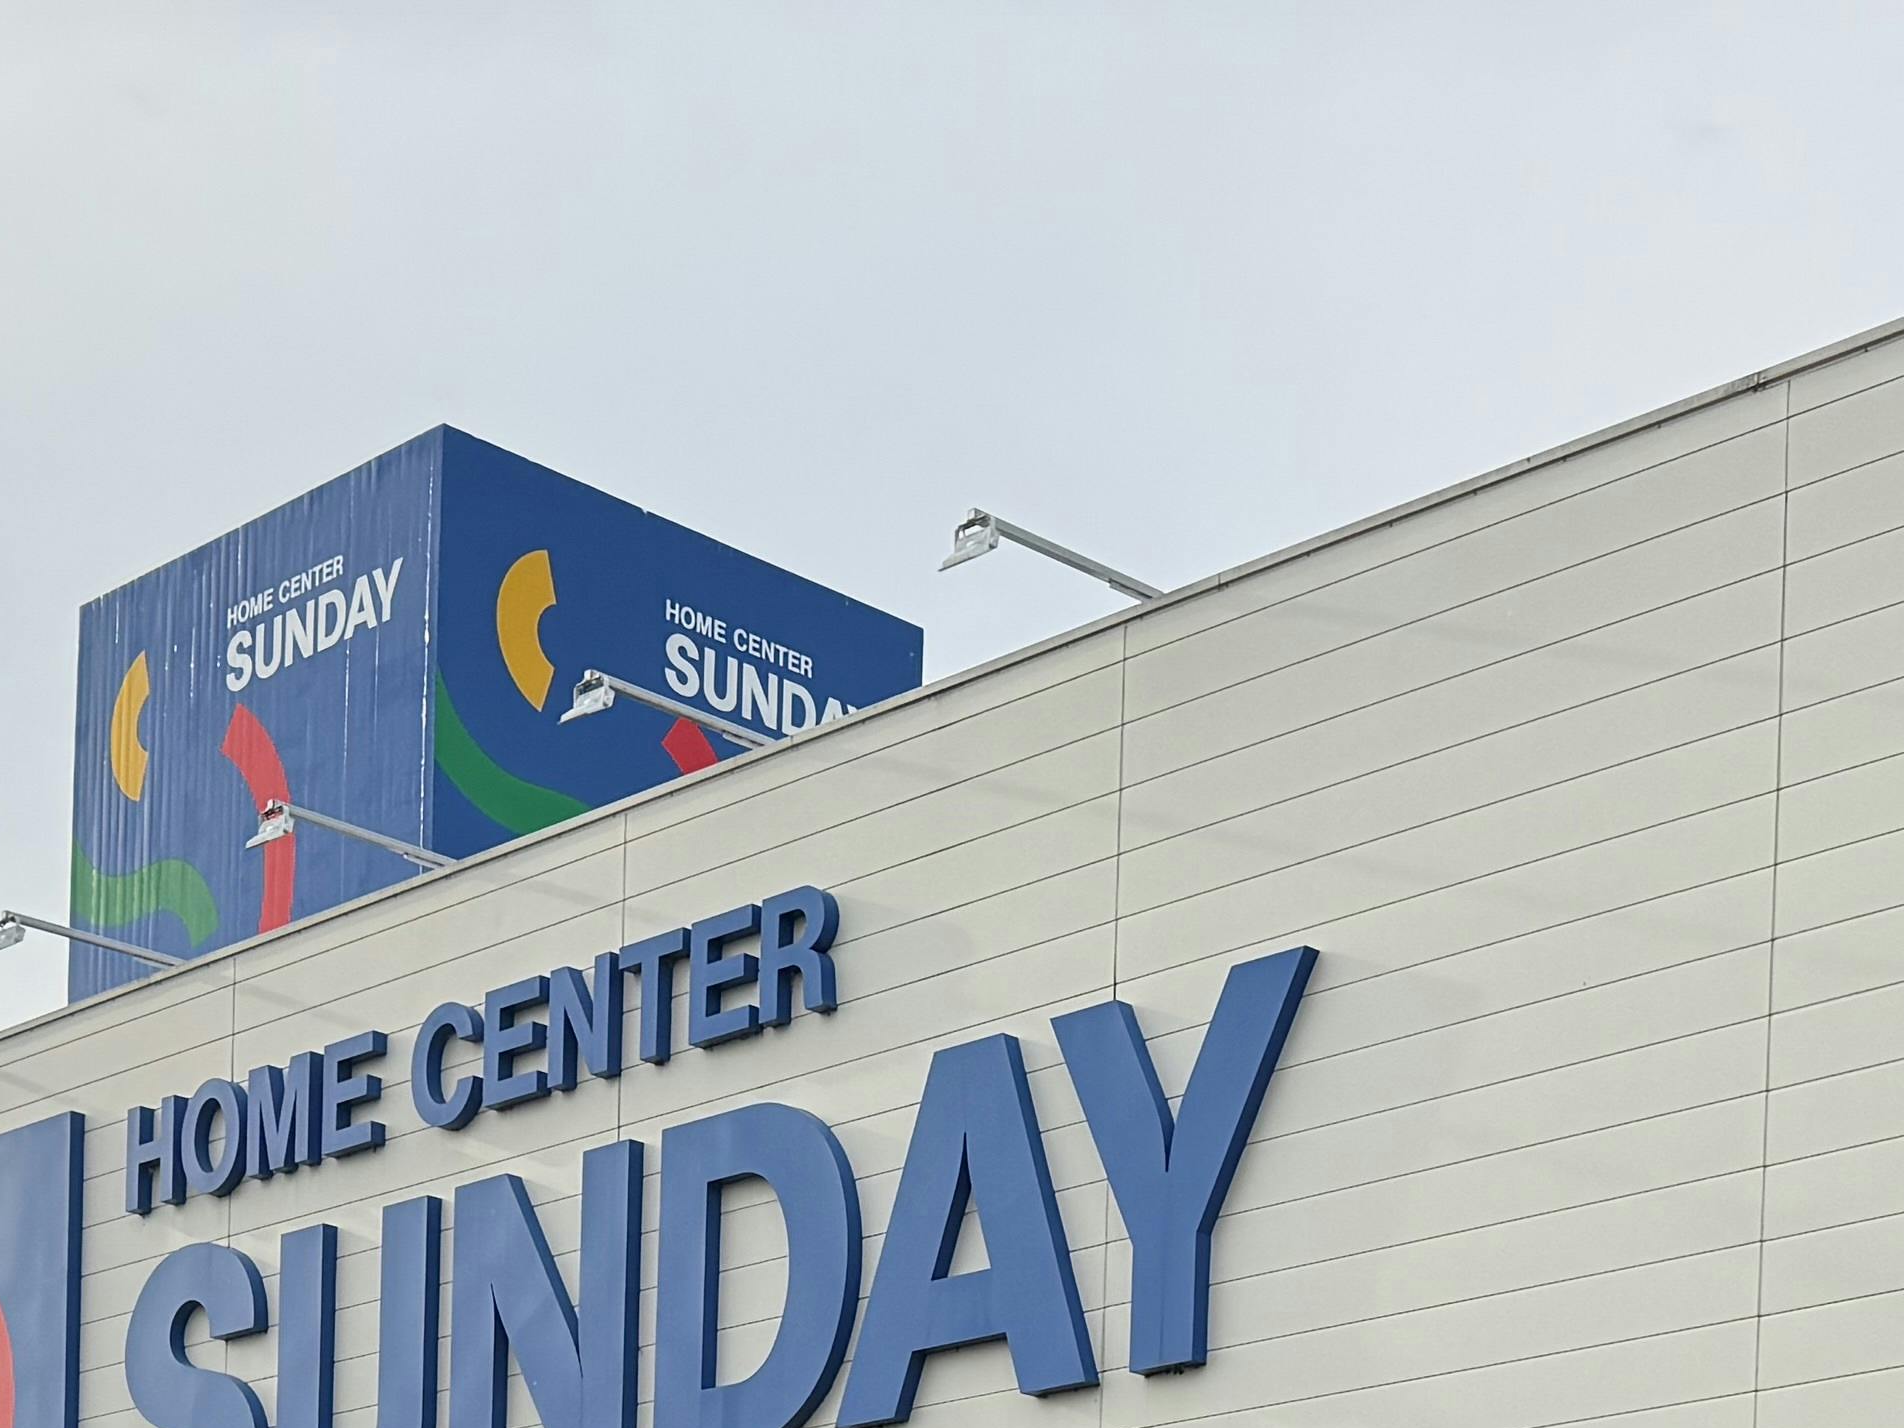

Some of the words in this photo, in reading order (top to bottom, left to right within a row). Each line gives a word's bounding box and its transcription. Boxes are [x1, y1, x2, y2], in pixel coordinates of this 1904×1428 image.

[225, 557, 405, 693] SUNDAY
[226, 587, 275, 628] HOME
[279, 555, 344, 601] CENTER
[665, 599, 728, 648] HOME
[733, 629, 813, 679] CENTER
[127, 1029, 388, 1215] HOME
[412, 885, 839, 1131] CENTER
